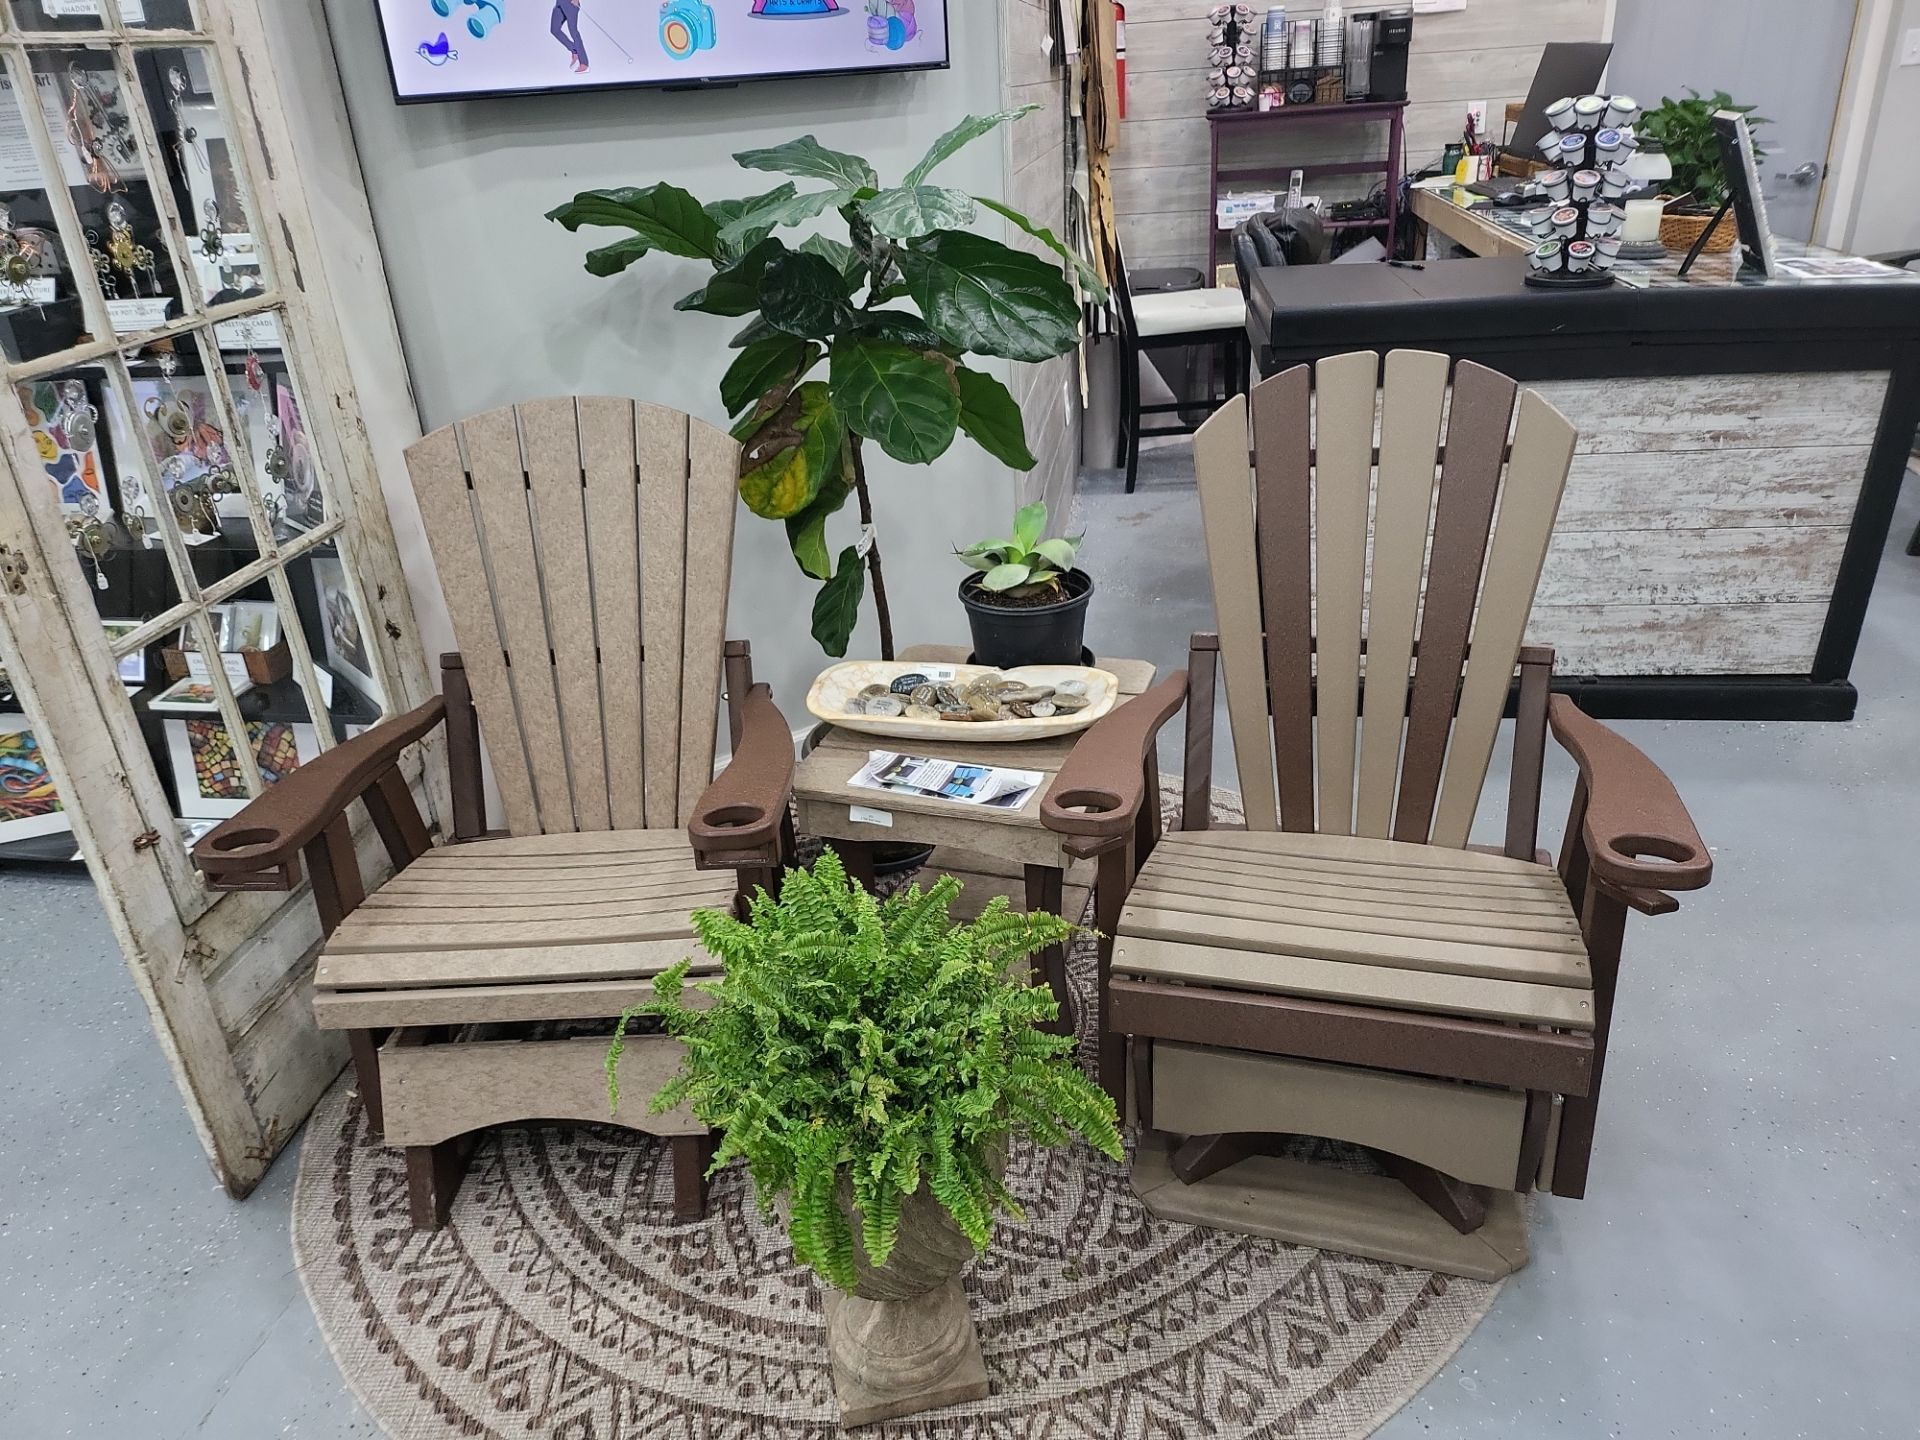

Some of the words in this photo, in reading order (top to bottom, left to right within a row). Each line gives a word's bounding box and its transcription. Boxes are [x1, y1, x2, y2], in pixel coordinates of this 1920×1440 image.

[61, 5, 91, 13] SHADOW
[35, 74, 51, 87] Art
[252, 319, 273, 327] CARDS
